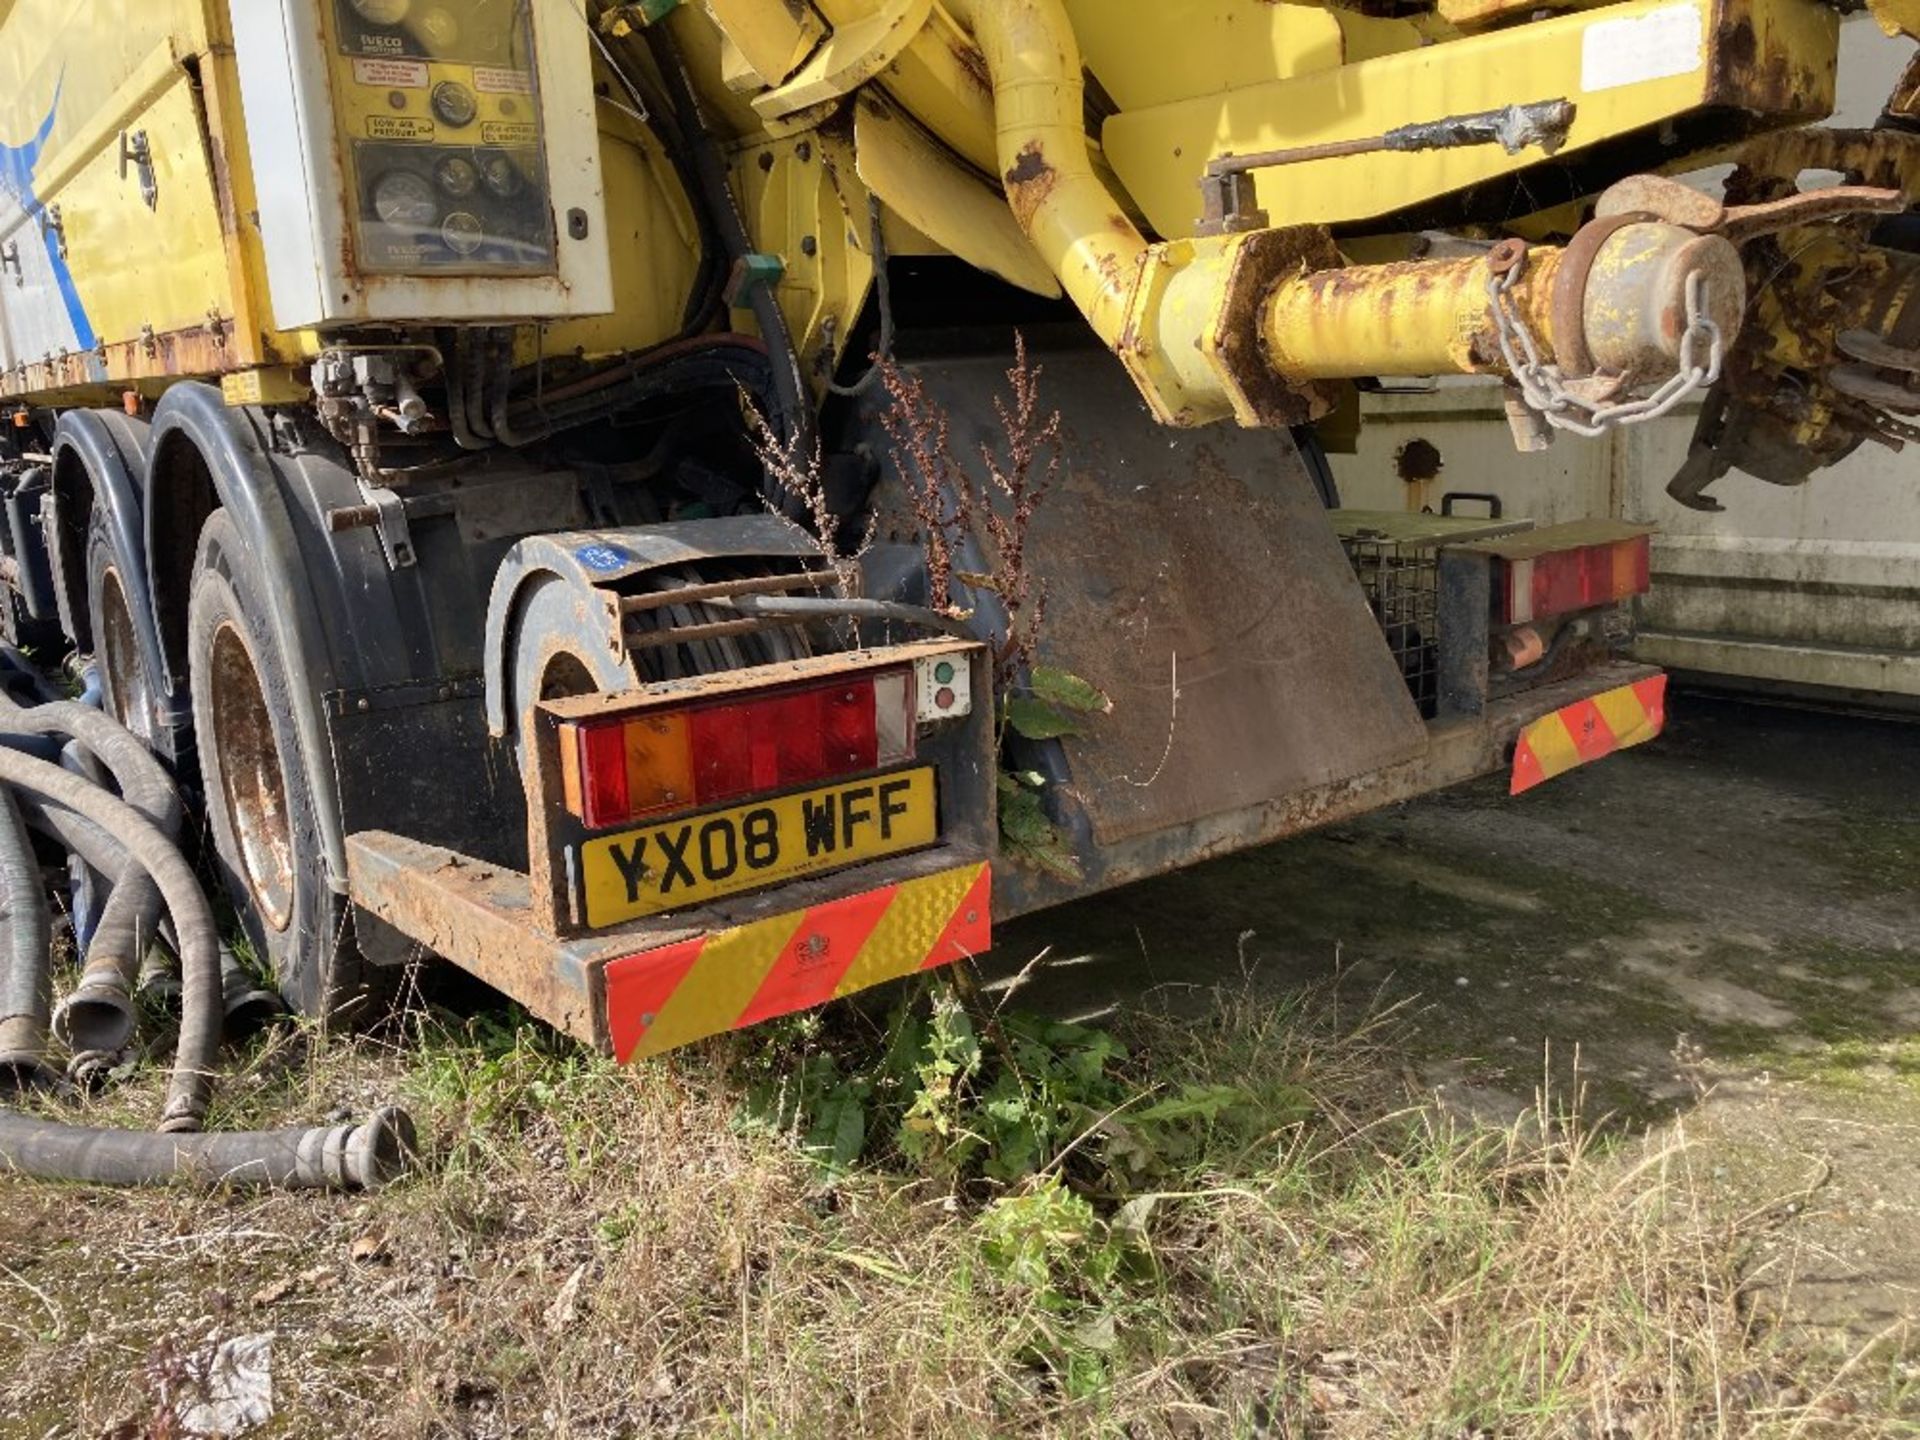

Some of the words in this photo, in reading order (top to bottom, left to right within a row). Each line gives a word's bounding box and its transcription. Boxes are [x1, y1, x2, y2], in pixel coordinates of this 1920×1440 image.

[360, 34, 401, 47] IVECO
[374, 119, 395, 128] LOW
[373, 128, 416, 137] PRESSURE
[608, 808, 779, 903] YX08
[801, 778, 911, 857] WFF
